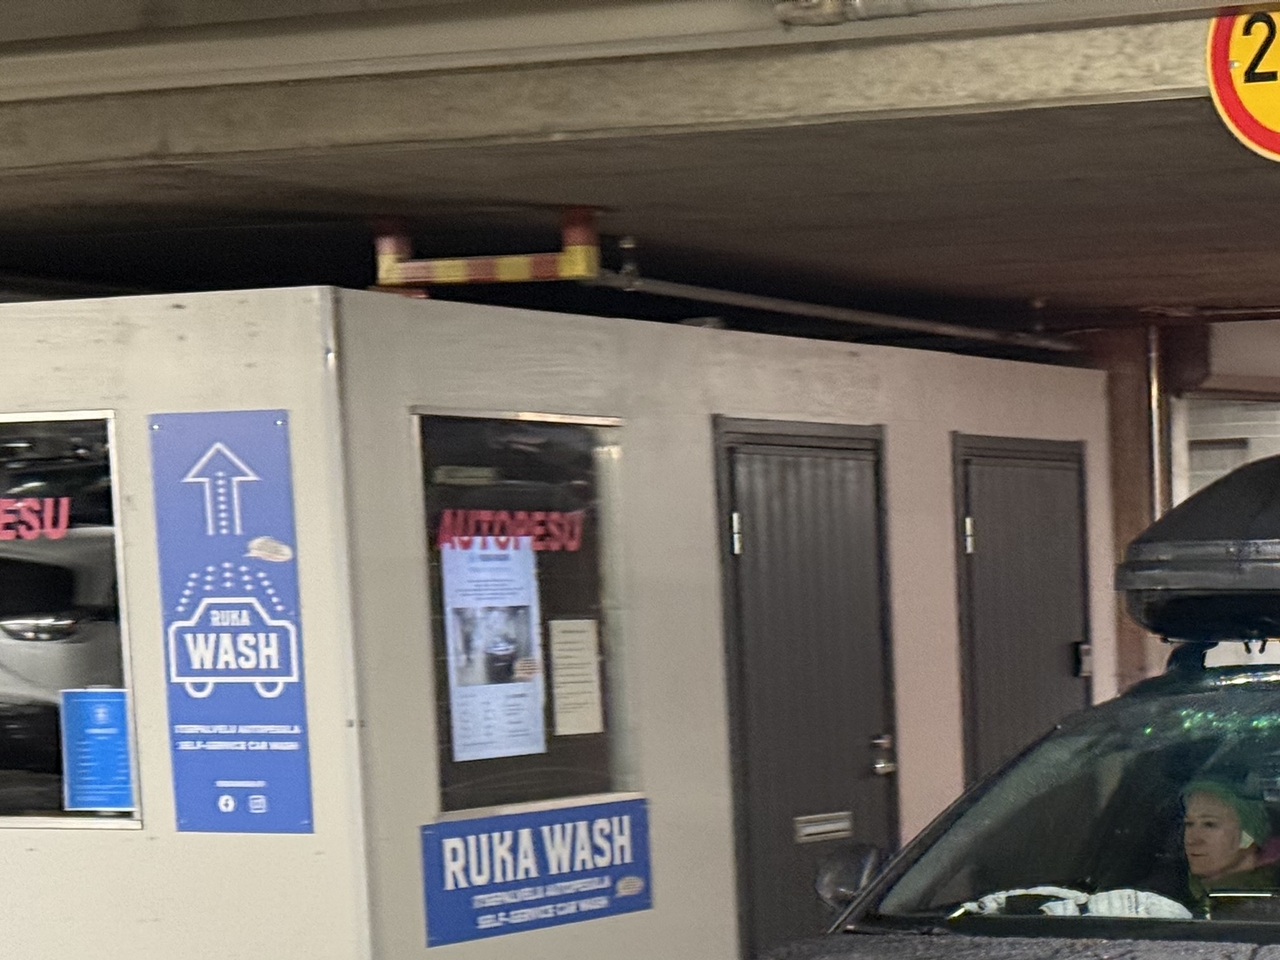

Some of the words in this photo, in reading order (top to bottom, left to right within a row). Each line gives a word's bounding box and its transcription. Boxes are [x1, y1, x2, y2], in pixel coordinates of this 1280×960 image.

[210, 610, 251, 626] RUKA
[184, 633, 281, 669] WASH
[442, 828, 540, 890] RUKA
[541, 815, 634, 875] WASH
